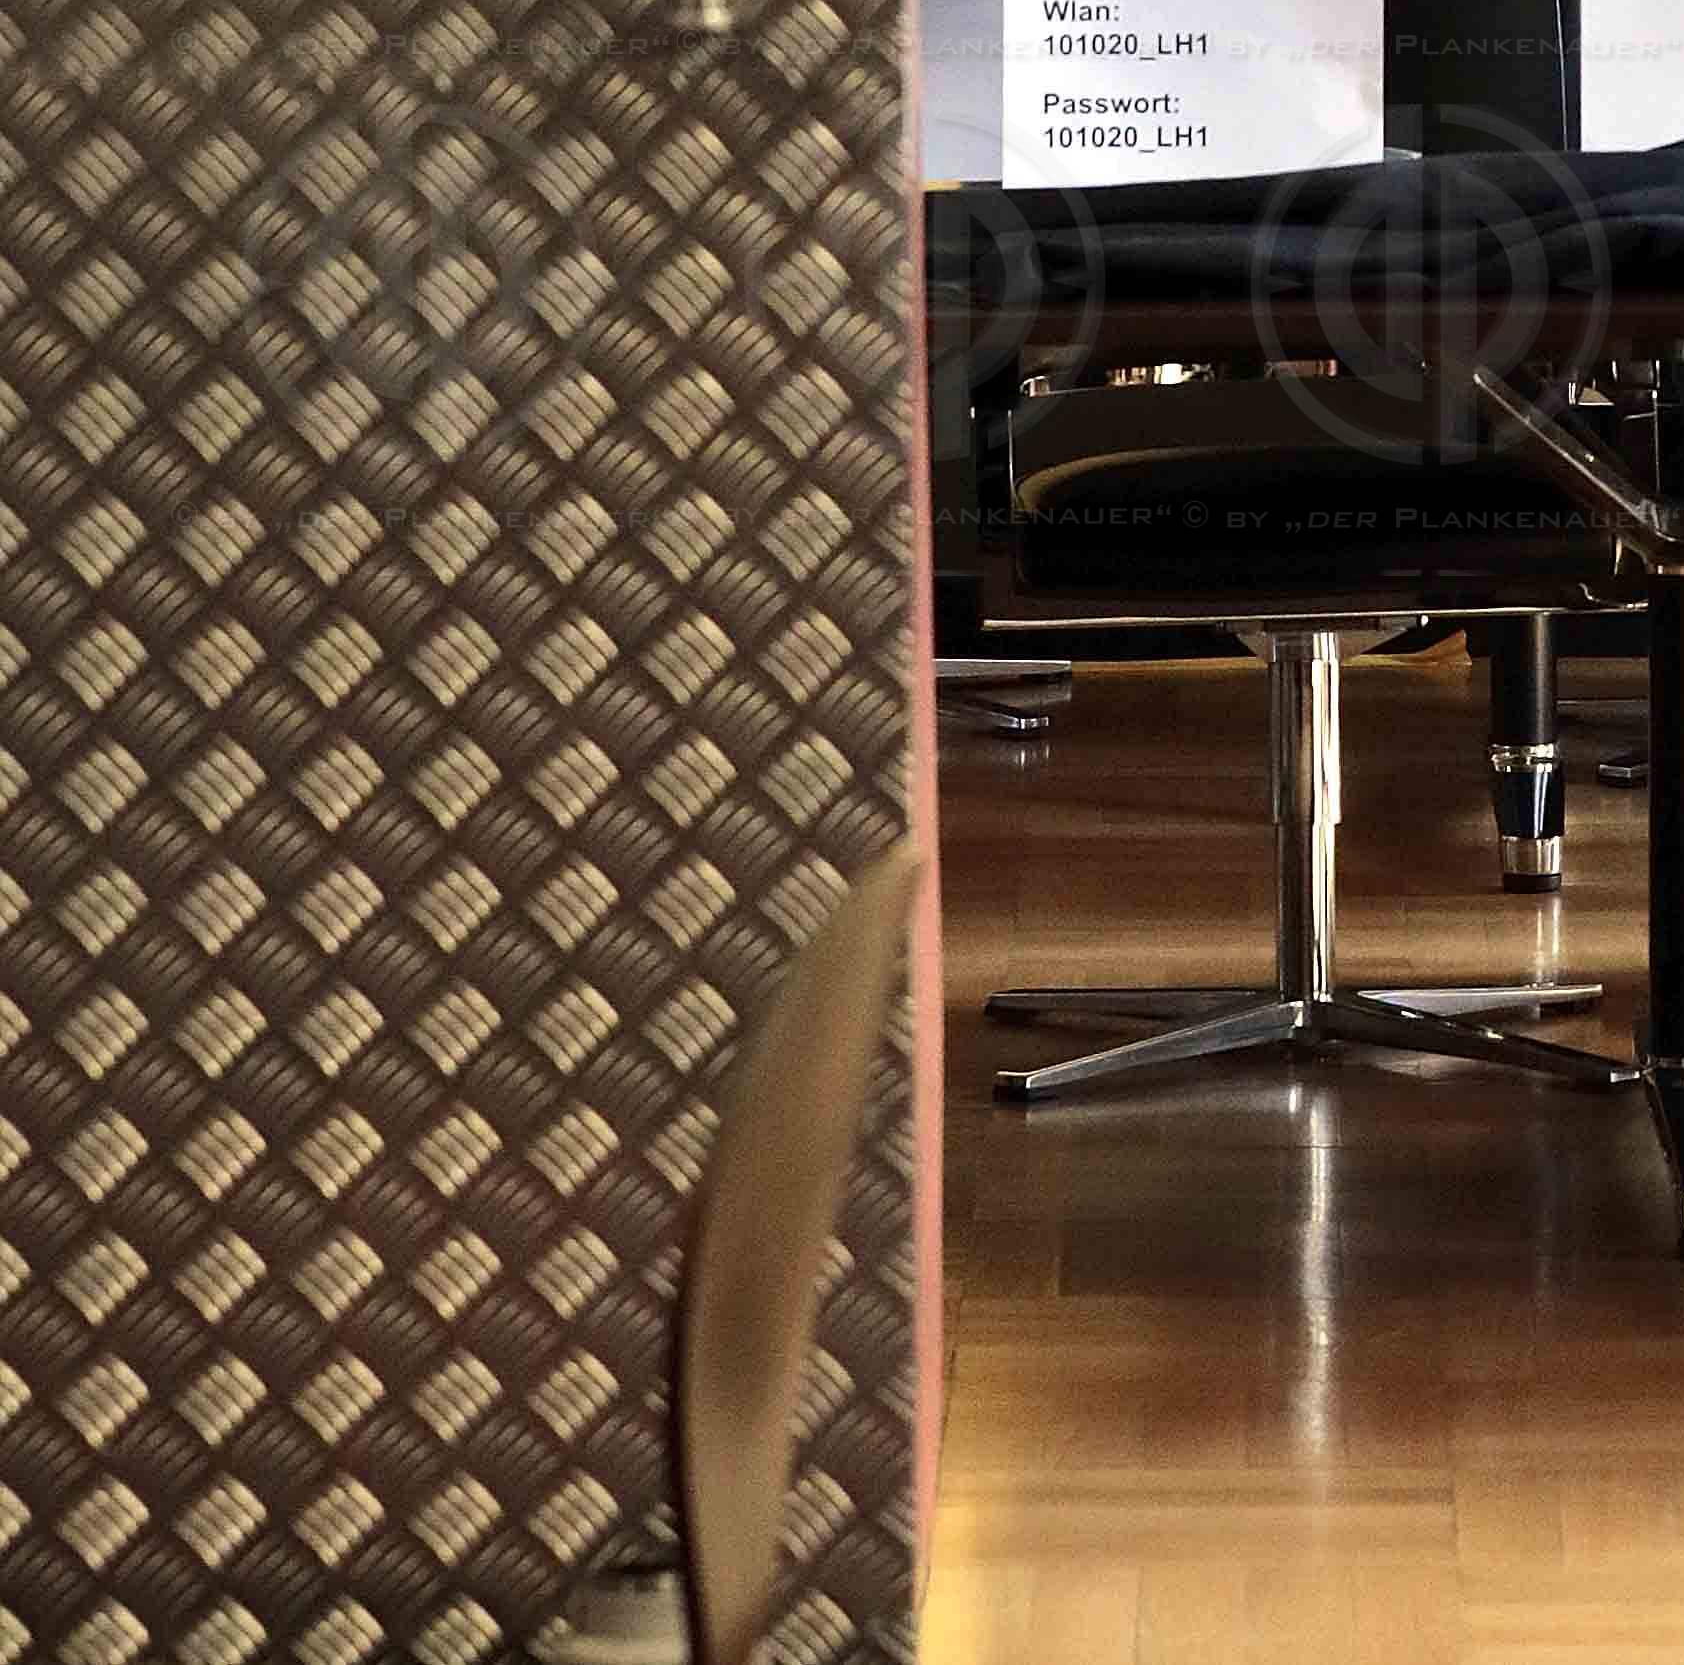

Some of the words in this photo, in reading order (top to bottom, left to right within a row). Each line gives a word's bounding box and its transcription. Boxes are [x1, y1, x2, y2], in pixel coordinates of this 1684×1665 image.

[1043, 1, 1120, 22] Wlan:
[1045, 33, 1209, 61] 101020_LH1
[1044, 93, 1180, 114] Passwort:
[1045, 126, 1209, 153] 101020_LH1
